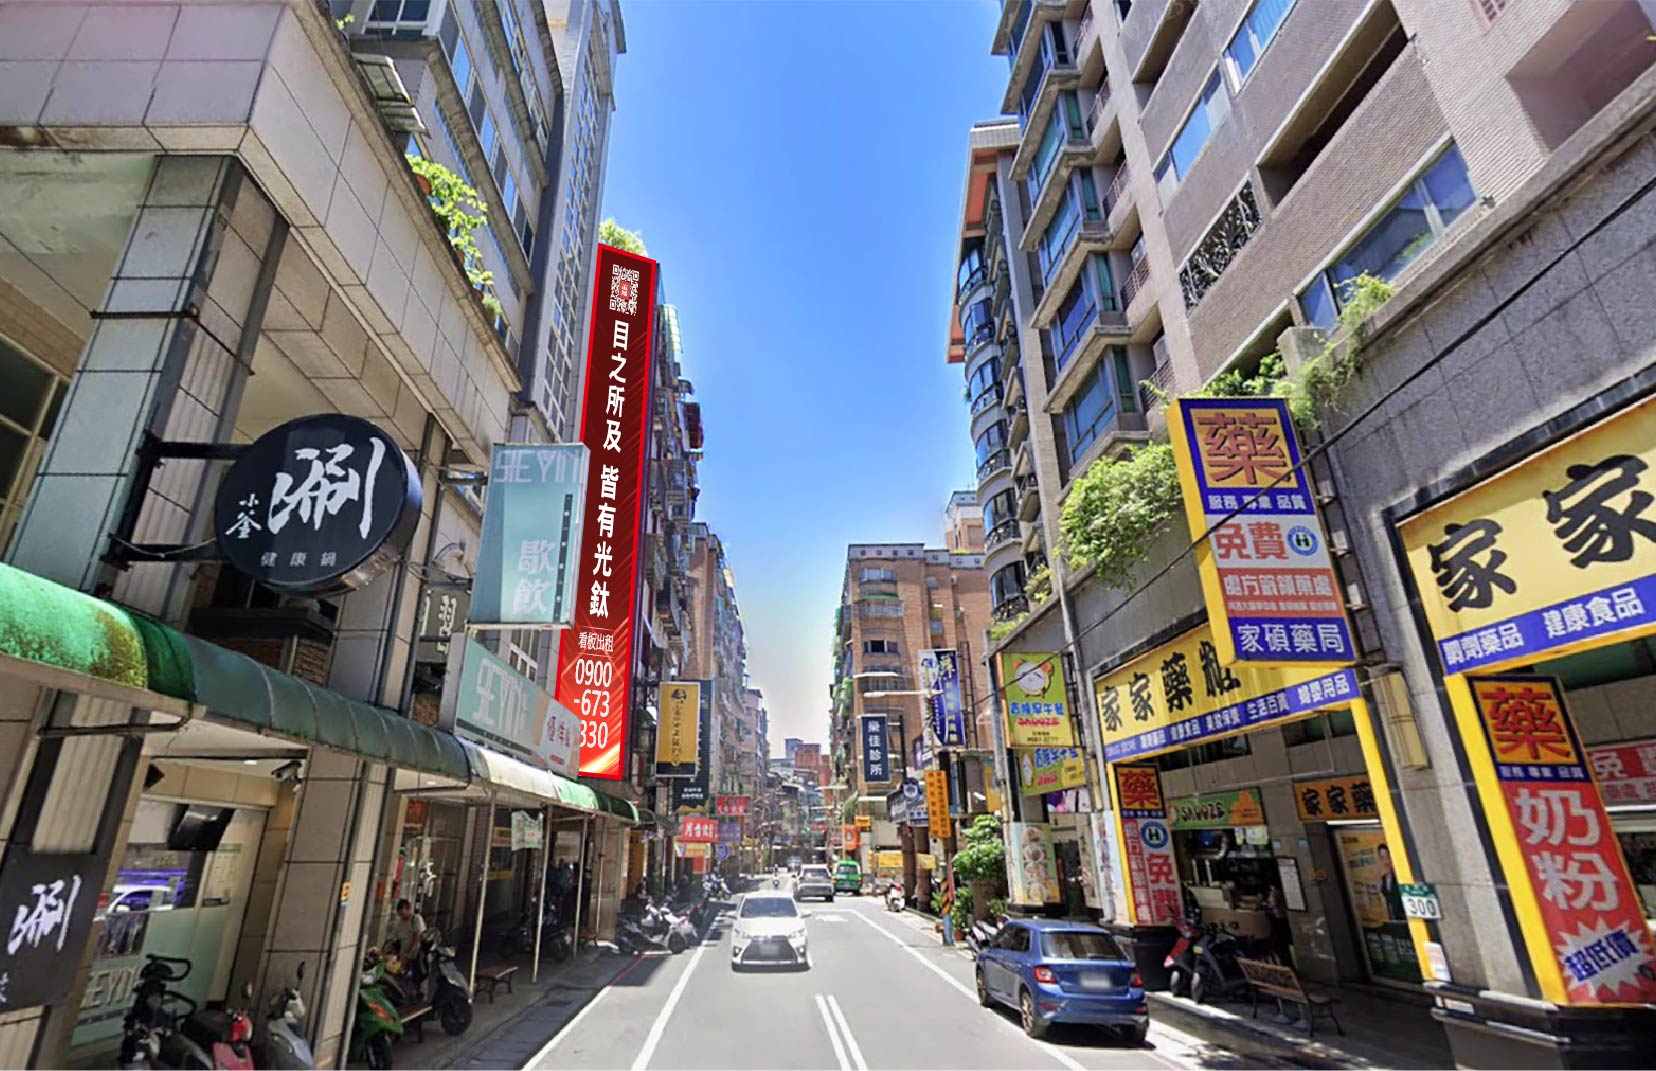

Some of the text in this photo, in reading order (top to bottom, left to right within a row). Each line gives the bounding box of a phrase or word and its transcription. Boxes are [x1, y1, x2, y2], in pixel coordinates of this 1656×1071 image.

[1197, 412, 1292, 485] 藥
[589, 319, 629, 619] 目之所及 皆有光鈦
[1276, 494, 1307, 509] 品質
[1213, 521, 1289, 560] 免費
[1427, 454, 1656, 613] 家家
[512, 539, 556, 615] 歇飲
[578, 632, 614, 652] 看板出租
[1237, 624, 1344, 653] 家碩藥局
[1442, 588, 1645, 665] 調劑藥品 健康食品
[575, 658, 612, 687] 0900
[573, 689, 610, 718] -673
[1246, 693, 1290, 719] 生活百貨
[1480, 686, 1571, 760] 藥
[1119, 770, 1160, 807] 藥
[1514, 787, 1620, 912] 奶粉
[1147, 854, 1181, 922] 免費
[1407, 898, 1436, 917] 300
